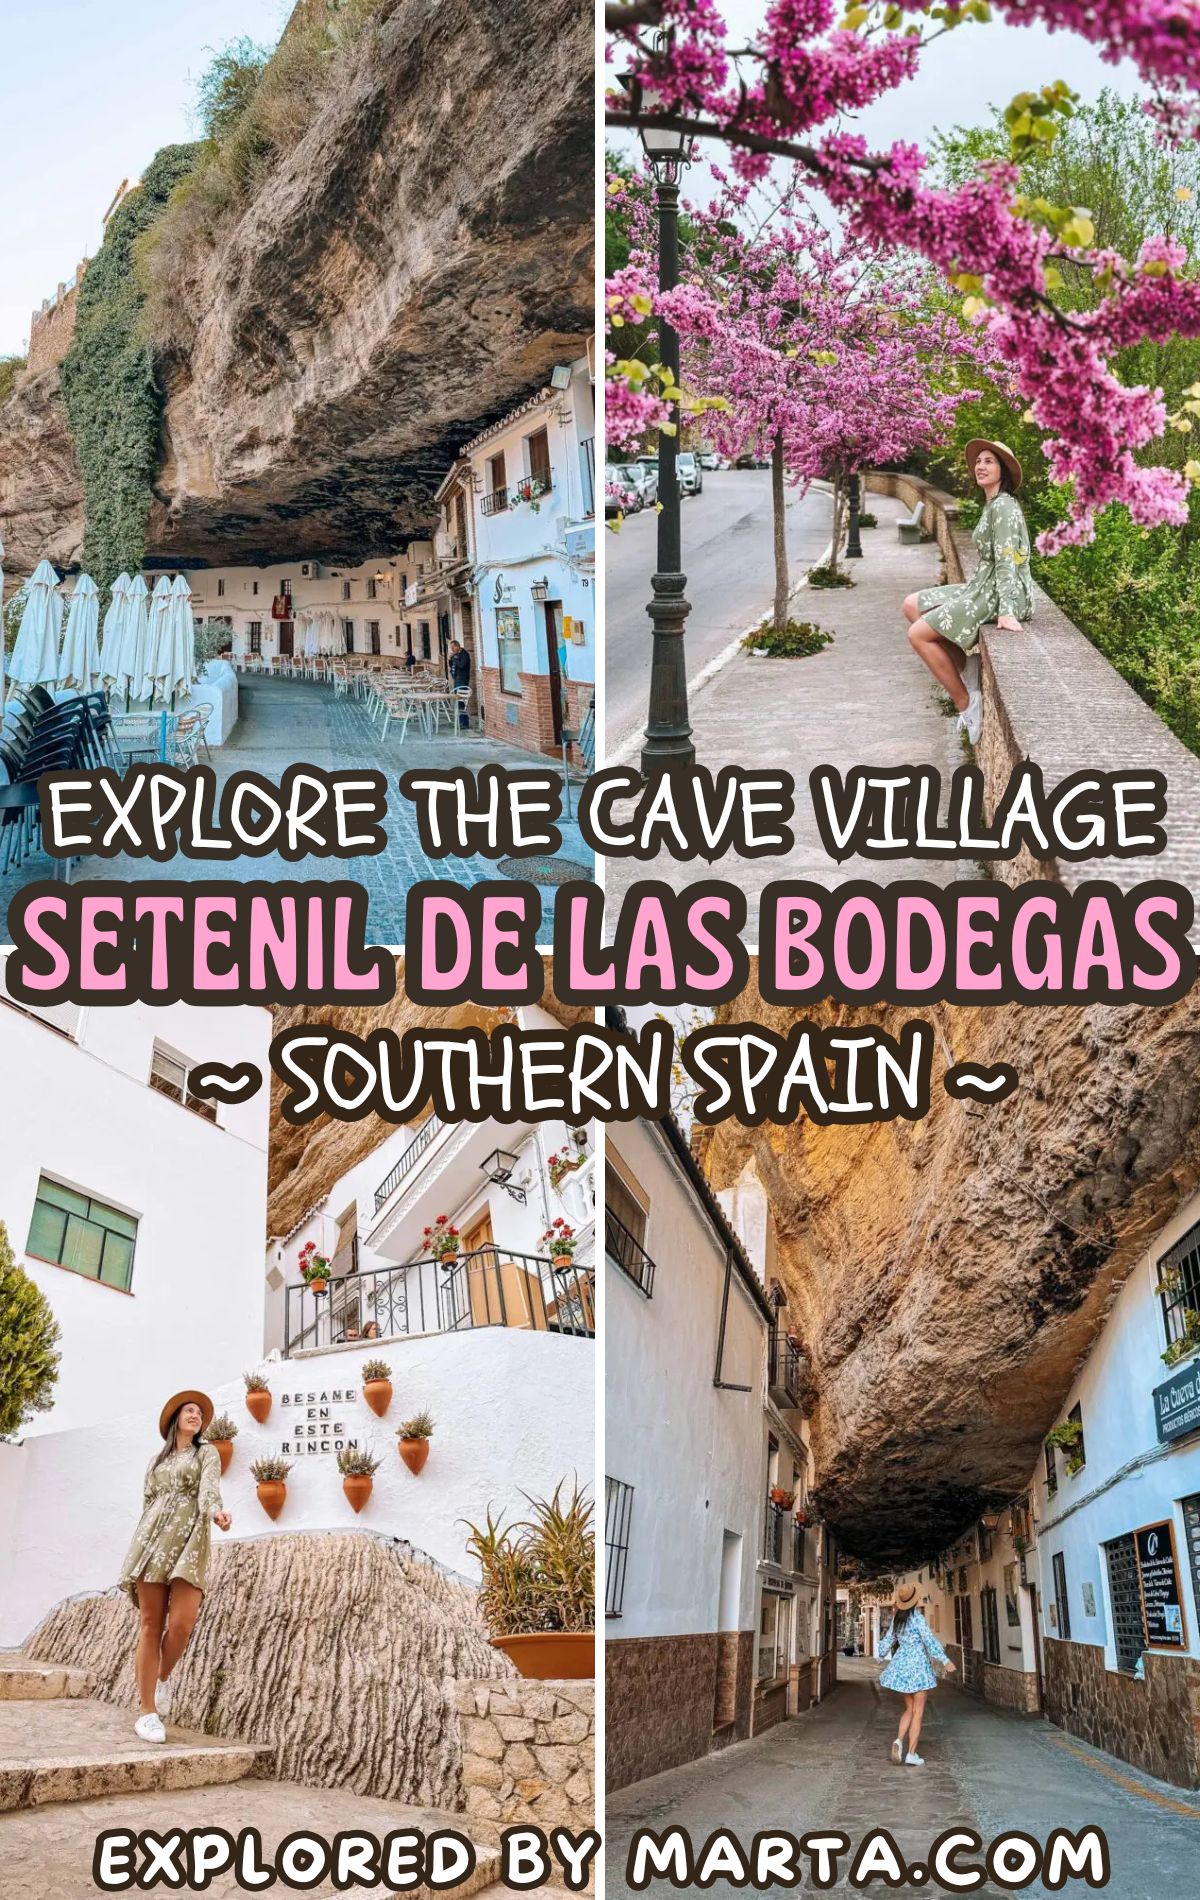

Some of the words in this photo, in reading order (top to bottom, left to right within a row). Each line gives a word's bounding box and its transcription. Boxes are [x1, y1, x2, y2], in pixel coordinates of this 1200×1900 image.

[581, 579, 589, 587] 79
[282, 1390, 355, 1403] BESAME
[1160, 1395, 1170, 1415] La
[1170, 1382, 1195, 1408] Cueva
[307, 1408, 329, 1418] EN
[294, 1423, 343, 1435] ESTE
[282, 1439, 358, 1453] RINCON
